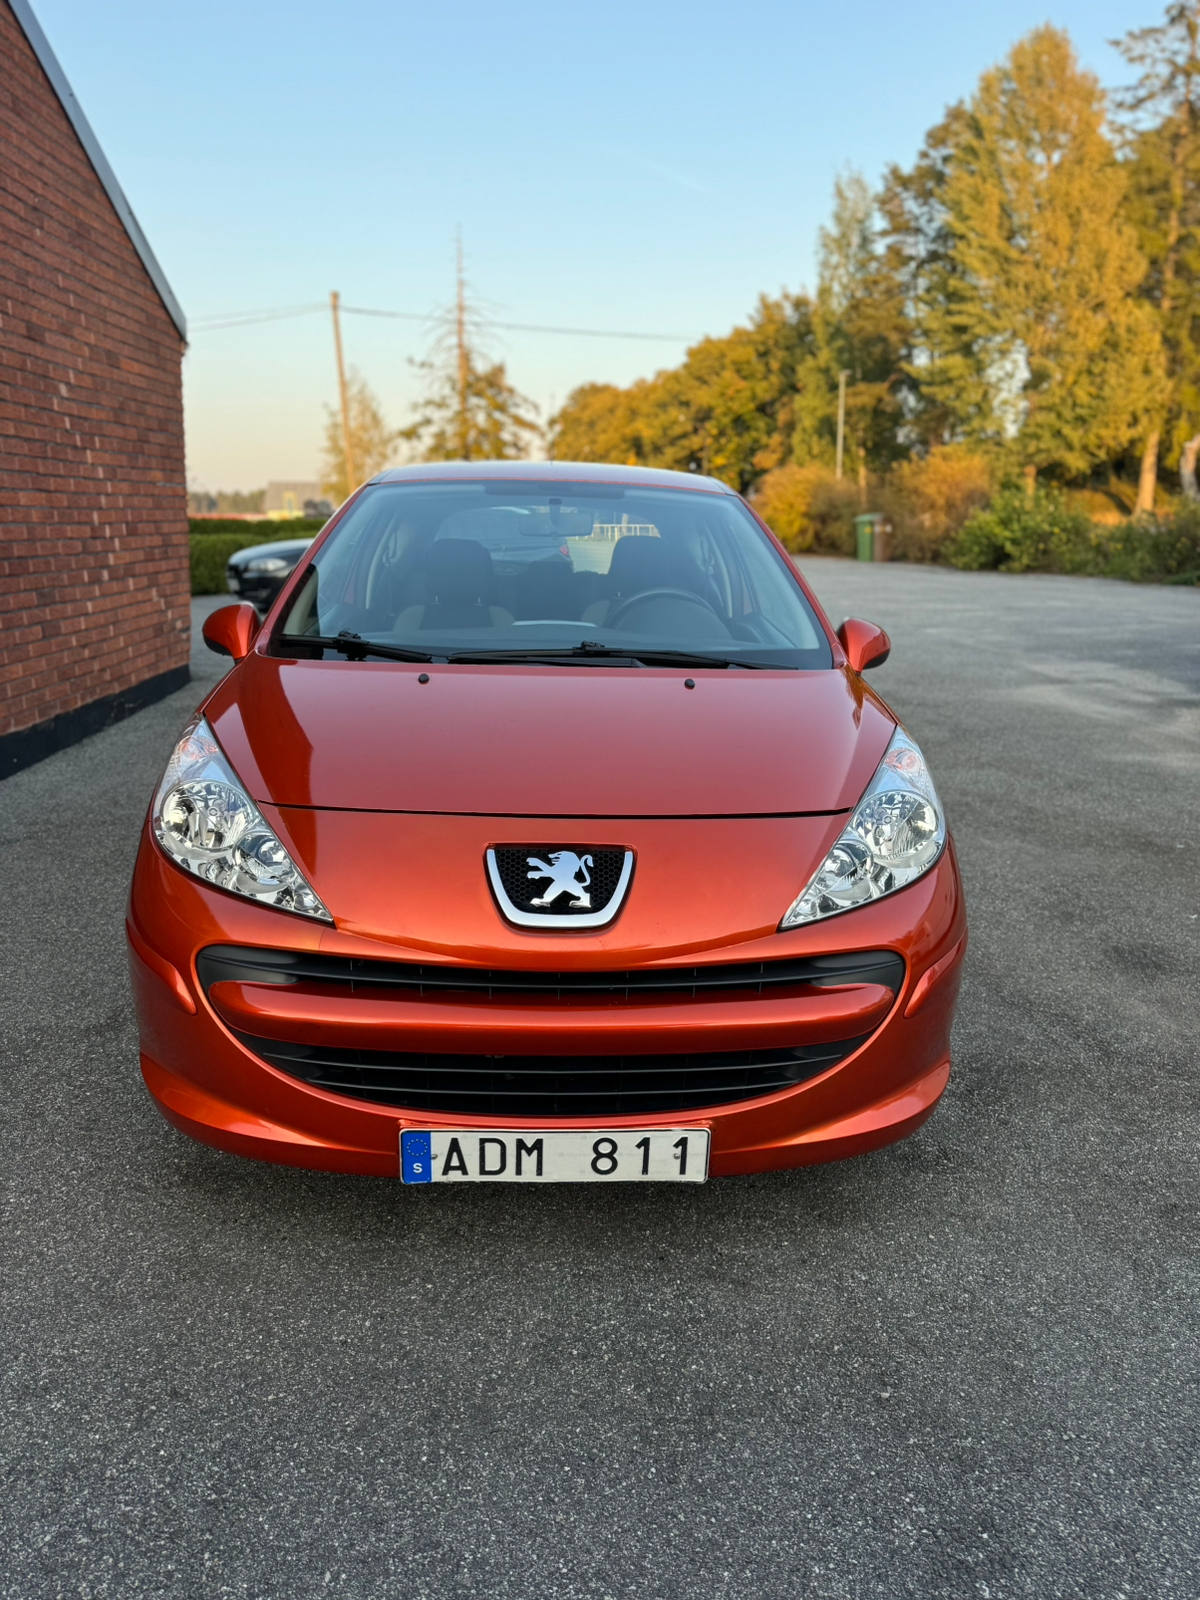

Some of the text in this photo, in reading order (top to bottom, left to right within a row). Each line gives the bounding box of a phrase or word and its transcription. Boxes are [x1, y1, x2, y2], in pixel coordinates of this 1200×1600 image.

[413, 1162, 423, 1174] S
[441, 1136, 689, 1176] ADM 811
